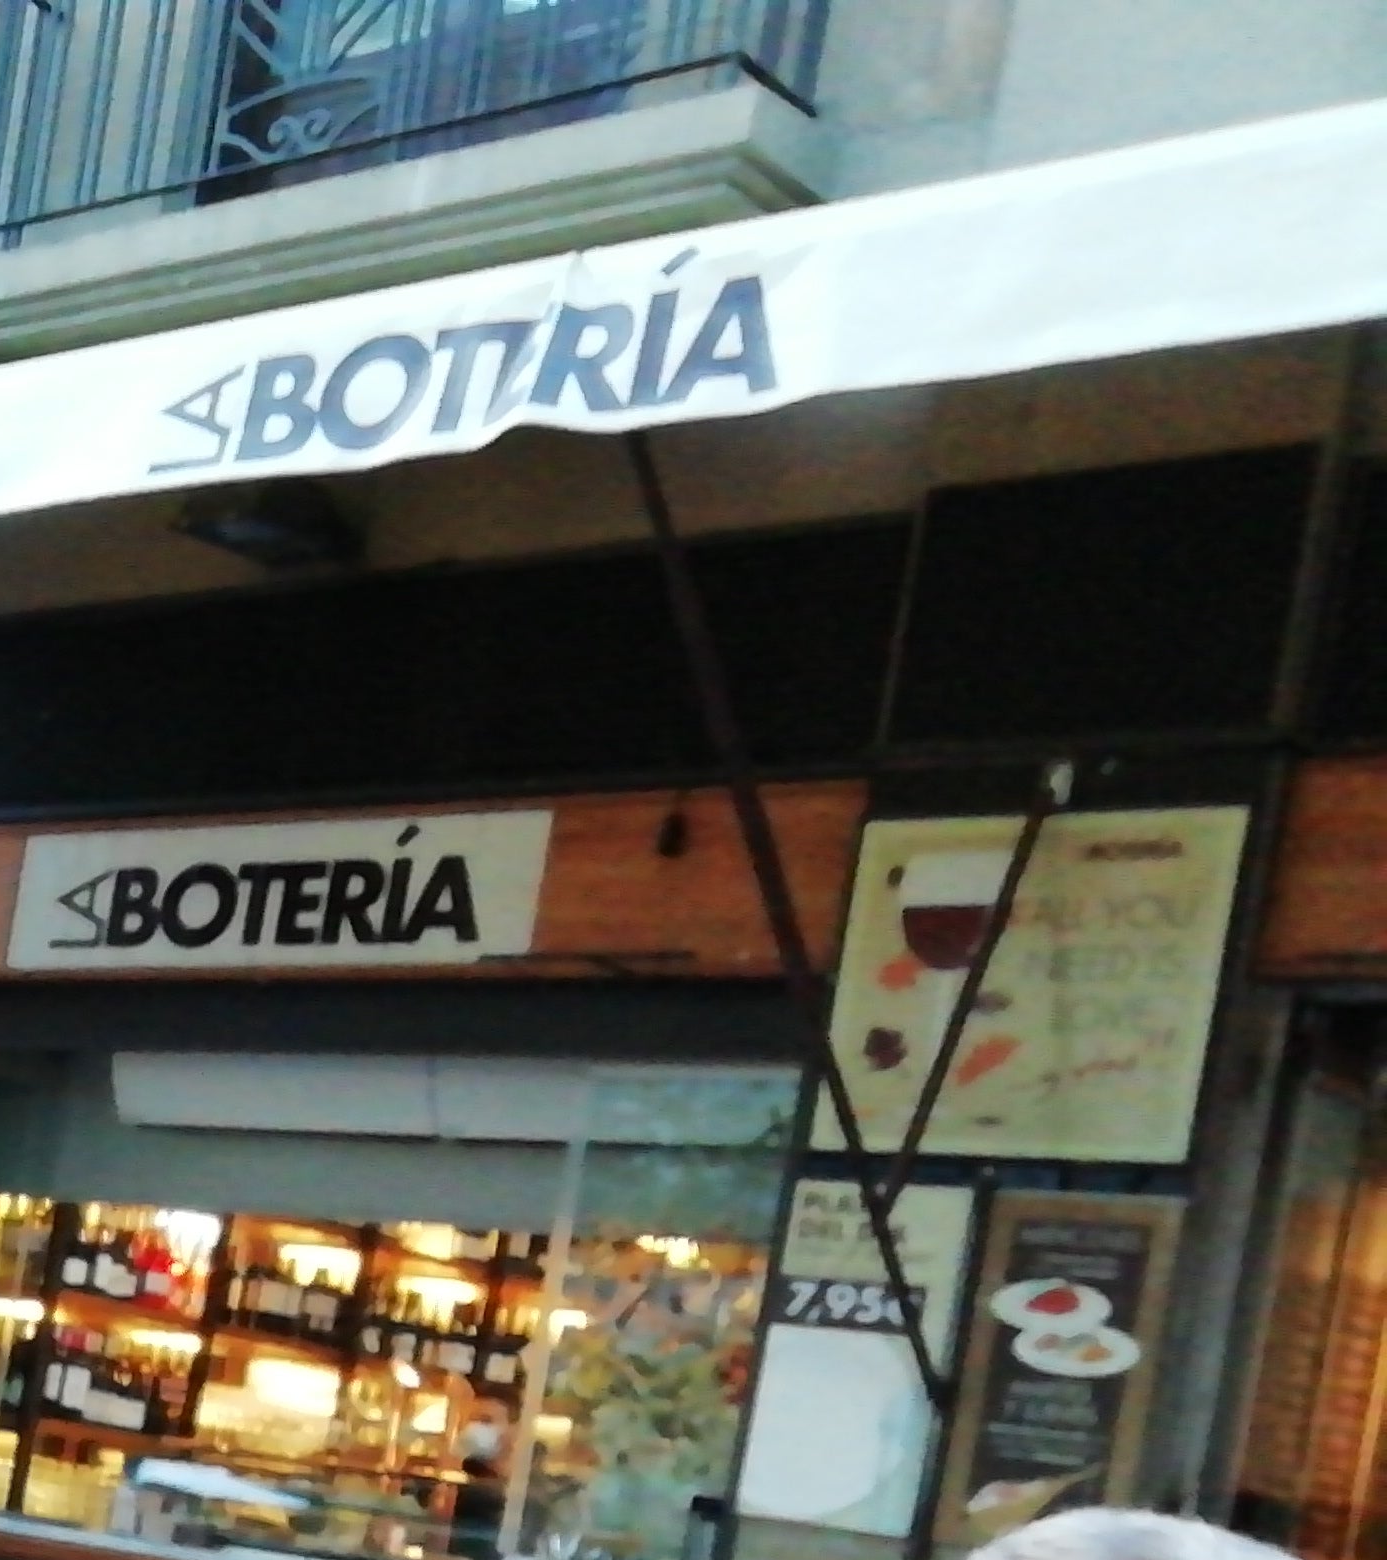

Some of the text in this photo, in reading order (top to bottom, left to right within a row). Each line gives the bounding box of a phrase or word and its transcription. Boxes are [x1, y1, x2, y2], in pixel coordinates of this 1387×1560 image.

[147, 364, 246, 475] LA
[47, 823, 480, 950] LA BOTERÍA
